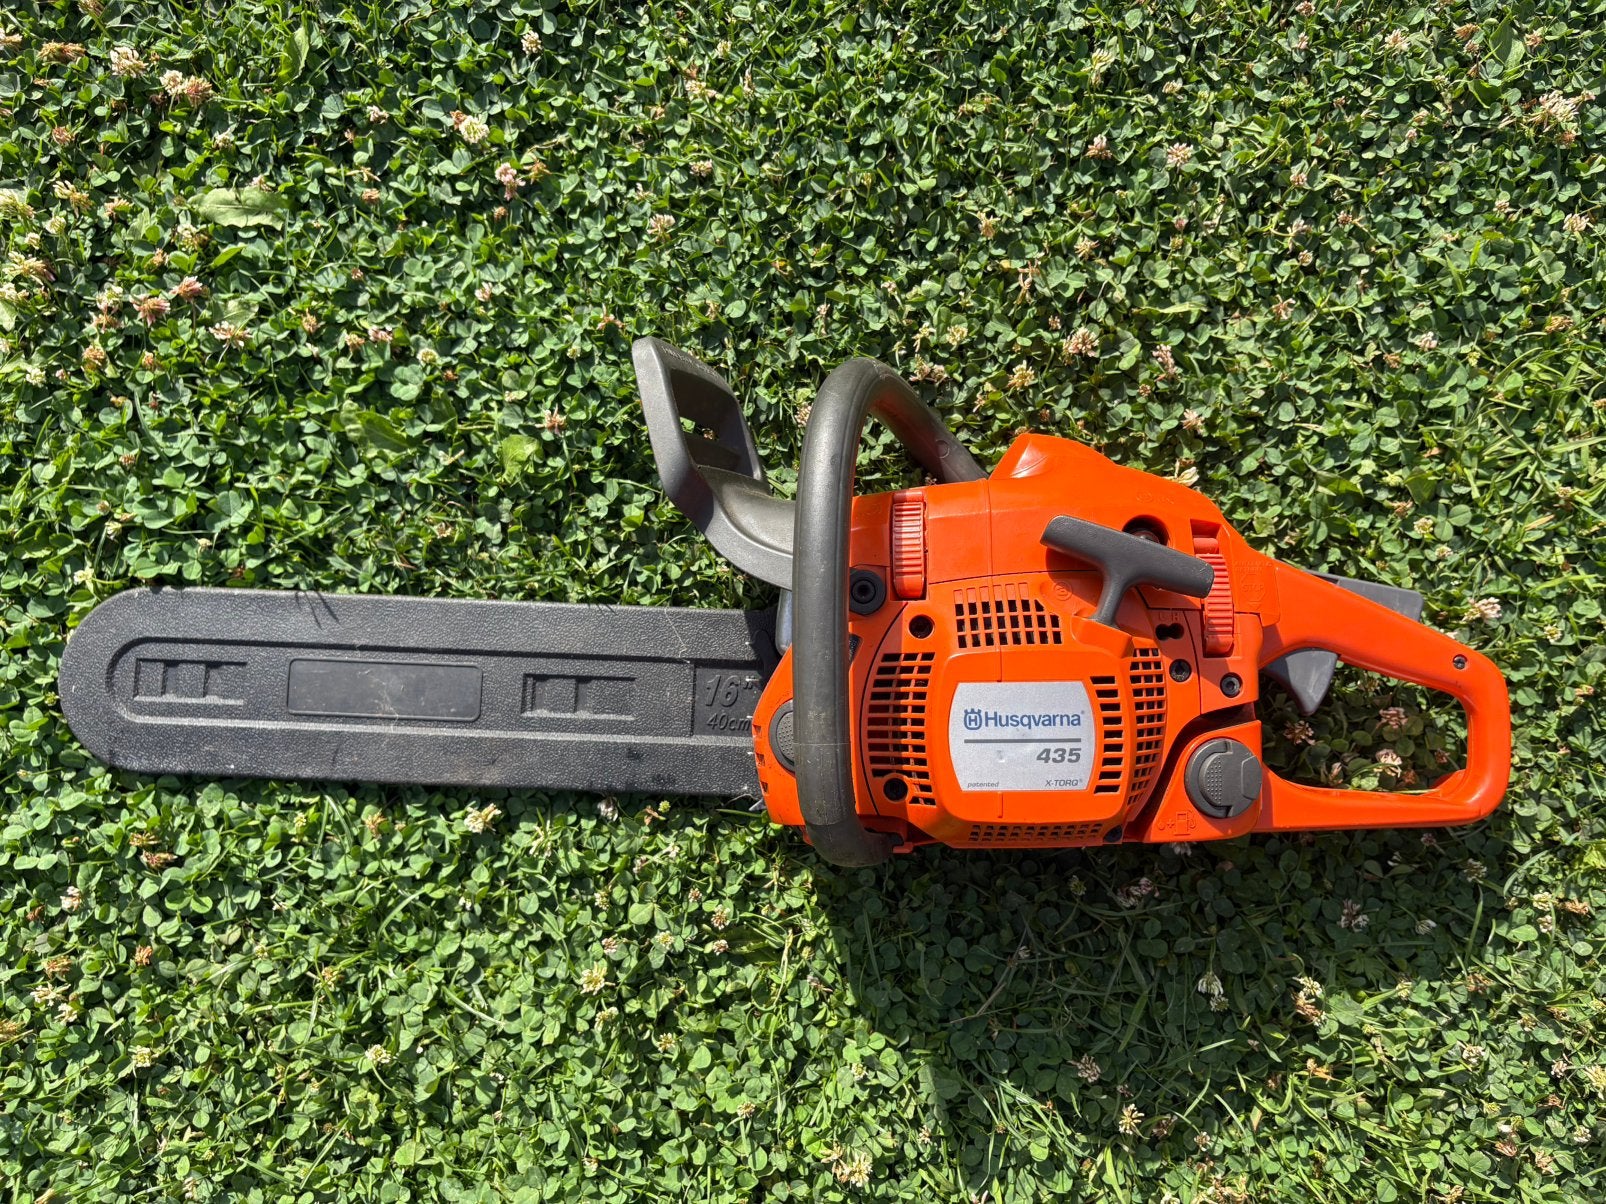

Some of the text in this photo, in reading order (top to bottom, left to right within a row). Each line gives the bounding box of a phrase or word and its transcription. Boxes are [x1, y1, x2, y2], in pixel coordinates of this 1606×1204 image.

[706, 713, 751, 731] 40cm
[984, 711, 1081, 730] Husqvarna
[1036, 748, 1082, 763] 435
